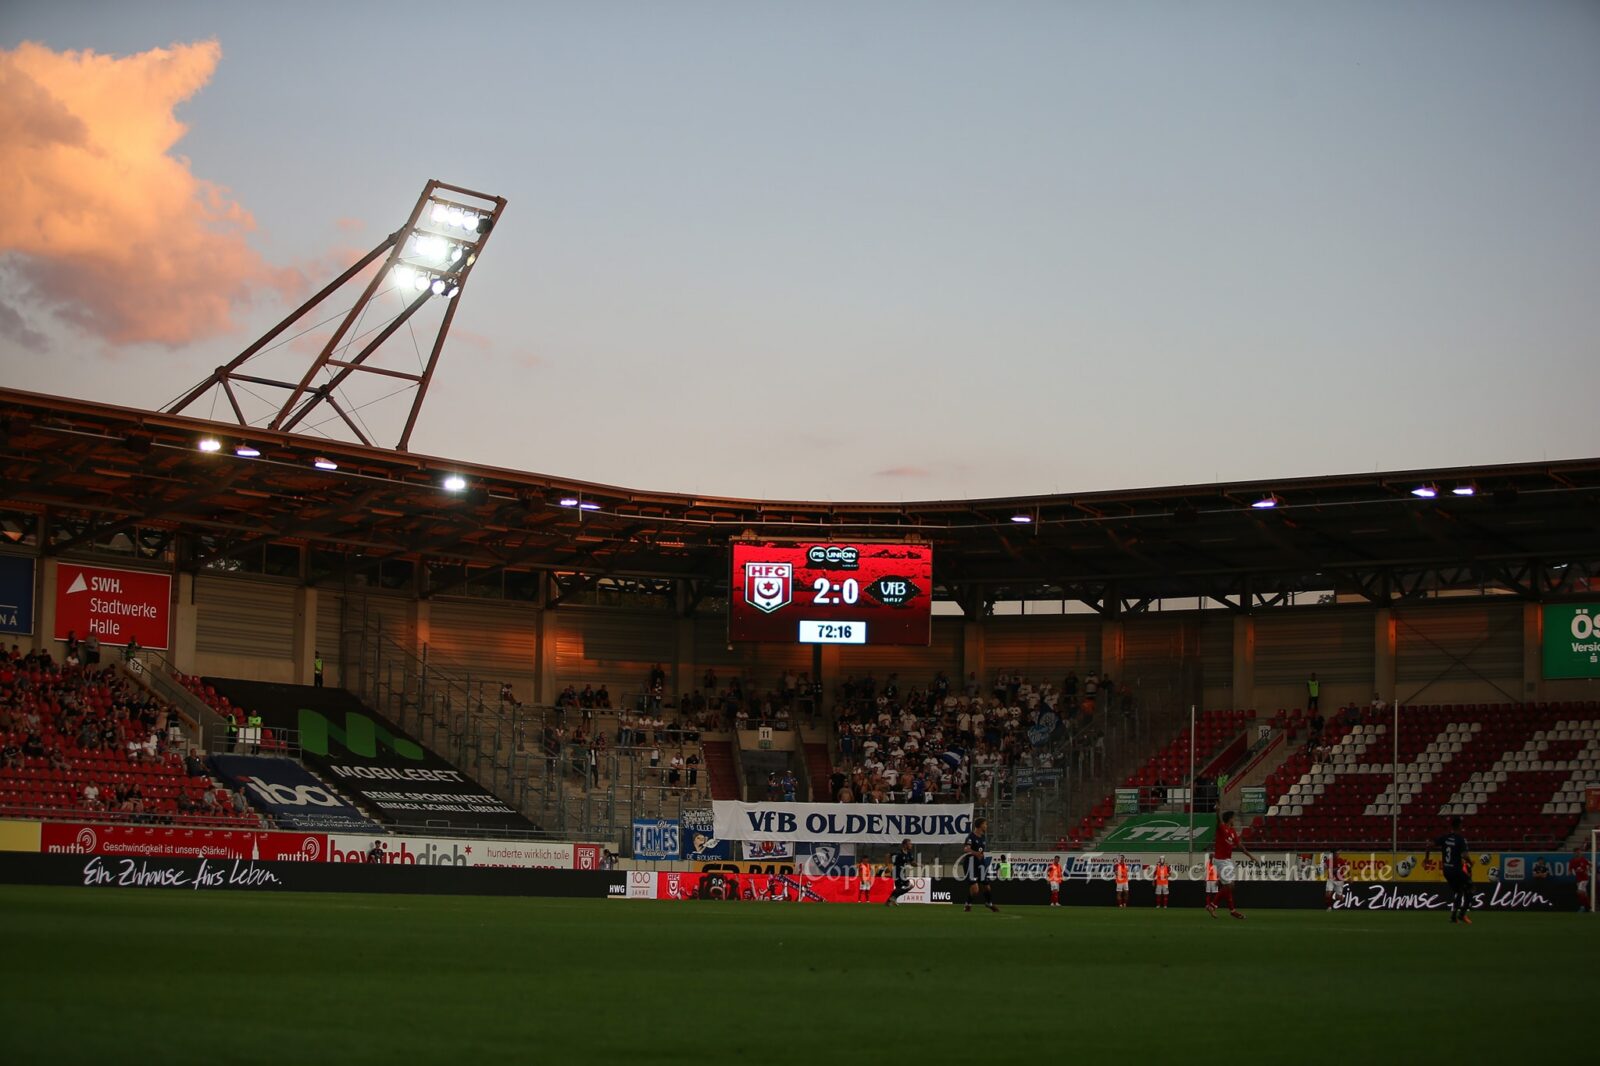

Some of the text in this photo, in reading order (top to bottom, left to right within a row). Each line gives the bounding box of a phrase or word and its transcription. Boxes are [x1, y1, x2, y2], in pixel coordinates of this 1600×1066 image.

[751, 566, 786, 577] HFC
[91, 576, 123, 594] SWH.
[813, 577, 859, 605] 2:0
[880, 581, 907, 596] VfB
[90, 597, 157, 619] Stadtwerke
[89, 618, 120, 635] Halle
[817, 624, 852, 639] 72:16
[329, 764, 465, 783] MOBILEBET
[746, 810, 973, 836] VfB OLDENBURG
[635, 827, 677, 851] FLAMES
[103, 841, 228, 856] Geschwindigkeit ist unsere Stärke!
[487, 847, 570, 860] hunderte wirklich tolle
[277, 851, 309, 862] muth
[83, 855, 283, 891] Ein Zuhause fürs Leben.
[631, 872, 651, 884] 100
[609, 884, 625, 894] HWG
[631, 889, 649, 897] JAHRE
[932, 891, 951, 900] HWG
[1367, 884, 1447, 910] Zuhause
[1489, 881, 1553, 907] Leben.
